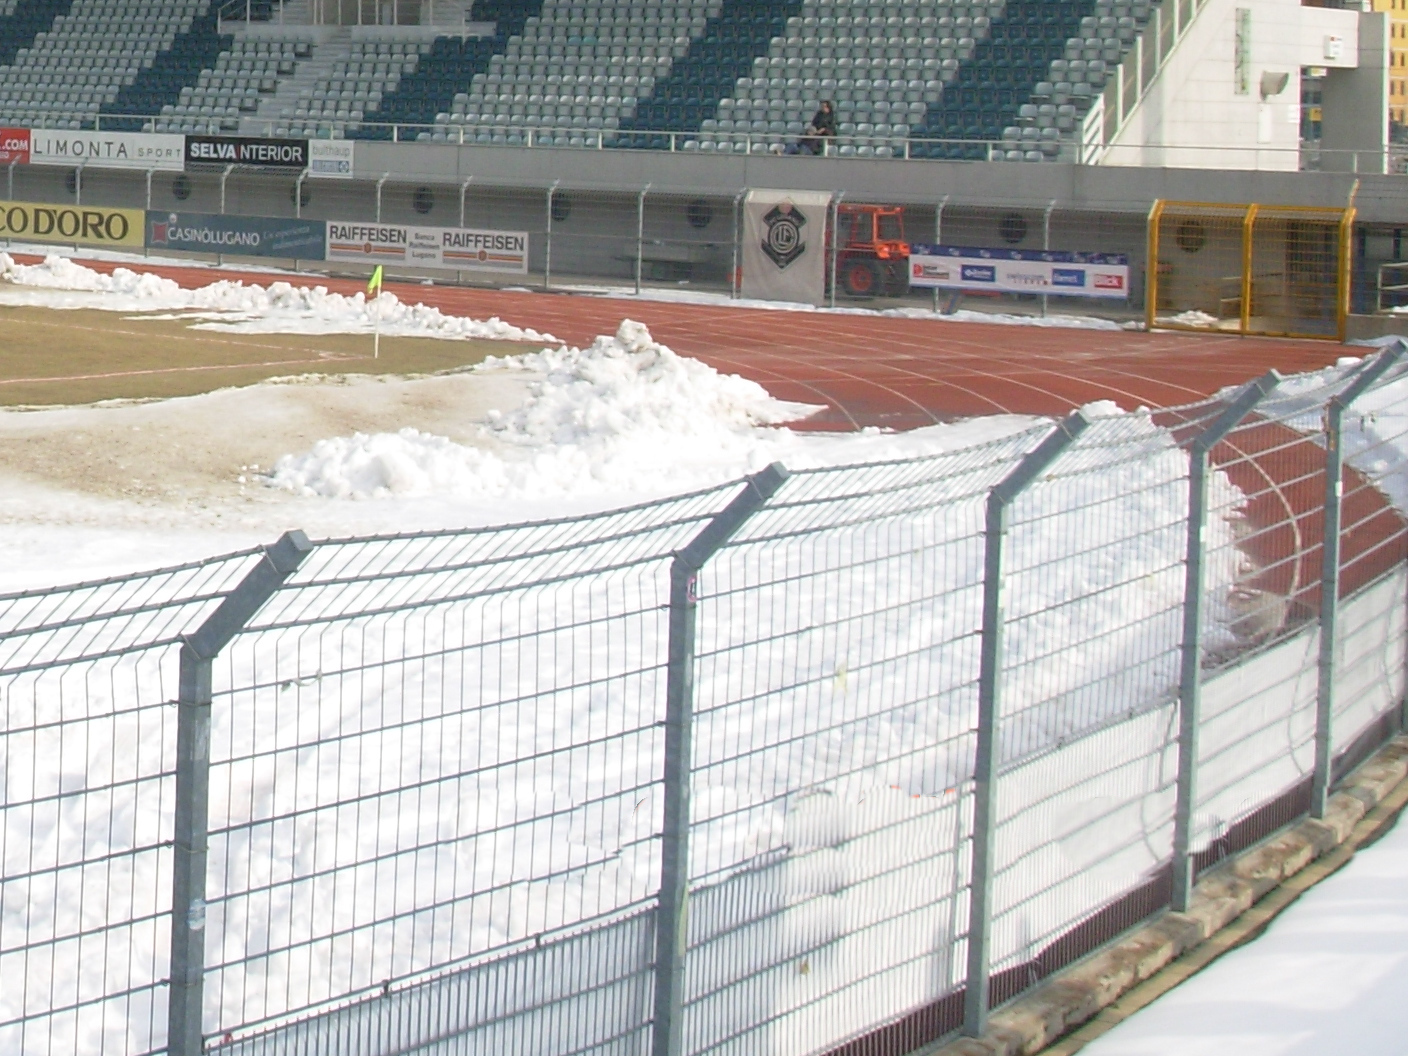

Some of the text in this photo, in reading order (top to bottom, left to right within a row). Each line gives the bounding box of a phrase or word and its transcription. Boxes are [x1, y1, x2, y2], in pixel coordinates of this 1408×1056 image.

[34, 139, 181, 158] LIMONTA SPORT
[33, 208, 129, 241] D'ORO
[168, 227, 260, 246] CASINÒLUGANO
[329, 225, 407, 244] RAIFFEISEN
[442, 232, 524, 251] RAIFFEISEN
